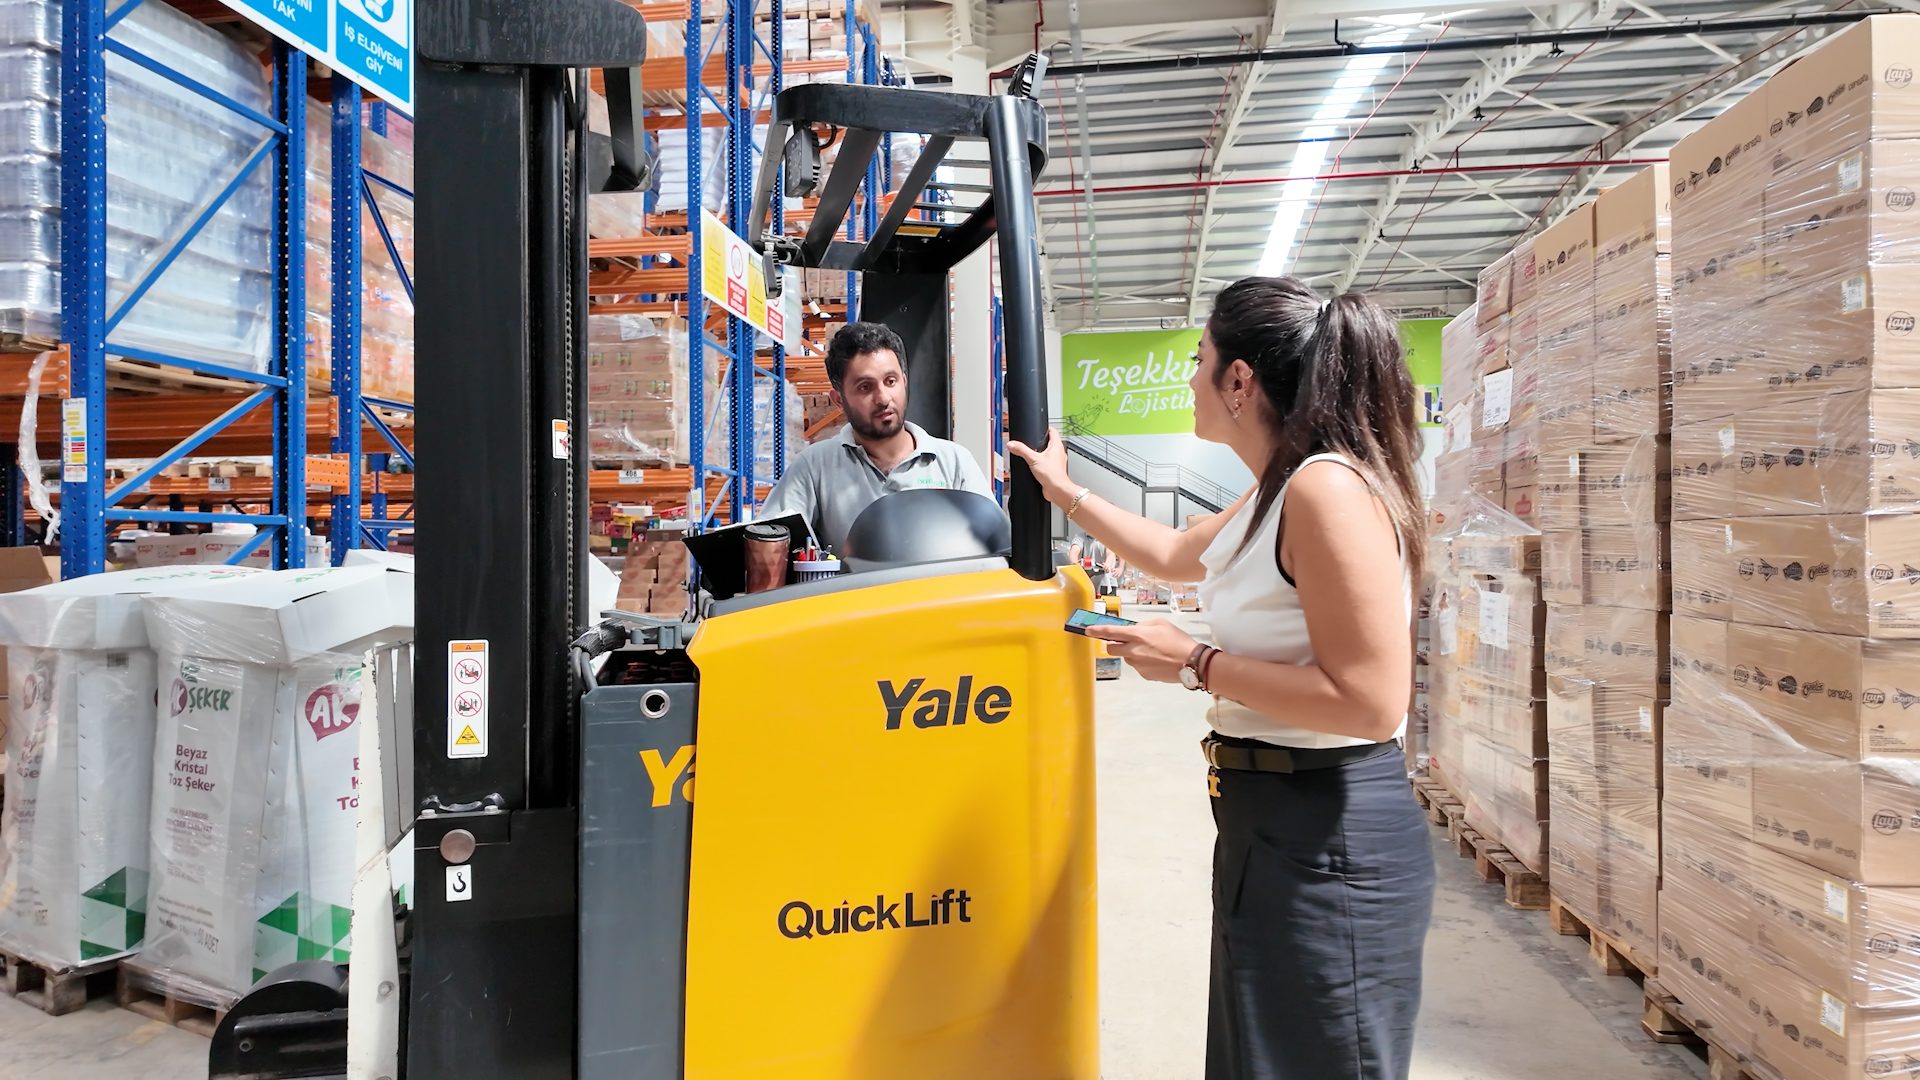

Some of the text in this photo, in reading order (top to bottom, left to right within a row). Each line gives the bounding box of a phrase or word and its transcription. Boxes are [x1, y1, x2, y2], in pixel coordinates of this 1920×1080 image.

[273, 0, 296, 21] TAK
[344, 21, 402, 72] İŞ ELDİVENİ
[365, 56, 384, 75] GİY
[188, 686, 232, 714] ŞEKER
[876, 675, 1013, 730] Yale
[310, 693, 352, 730] AK
[176, 744, 208, 761] Beyaz
[174, 760, 208, 775] Kristal
[169, 773, 216, 792] Toz Şeker
[337, 797, 359, 811] To
